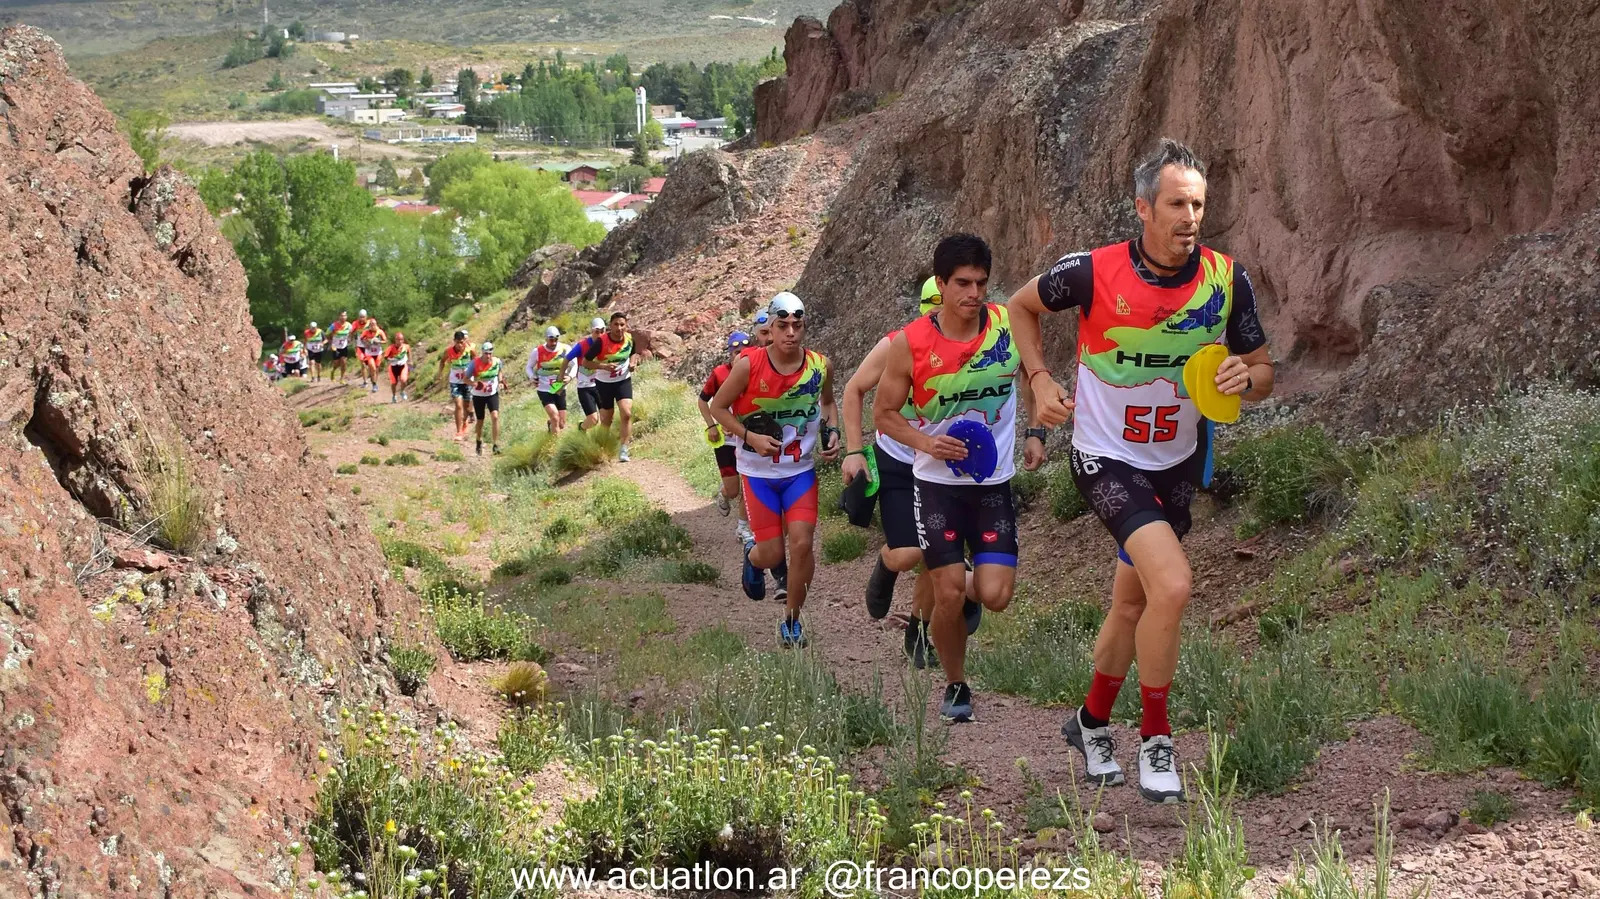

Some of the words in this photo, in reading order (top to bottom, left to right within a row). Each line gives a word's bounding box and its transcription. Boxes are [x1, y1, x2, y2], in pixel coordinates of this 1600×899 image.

[1050, 258, 1081, 275] ANDORRA
[1116, 350, 1191, 368] HEA
[1122, 404, 1181, 444] 55
